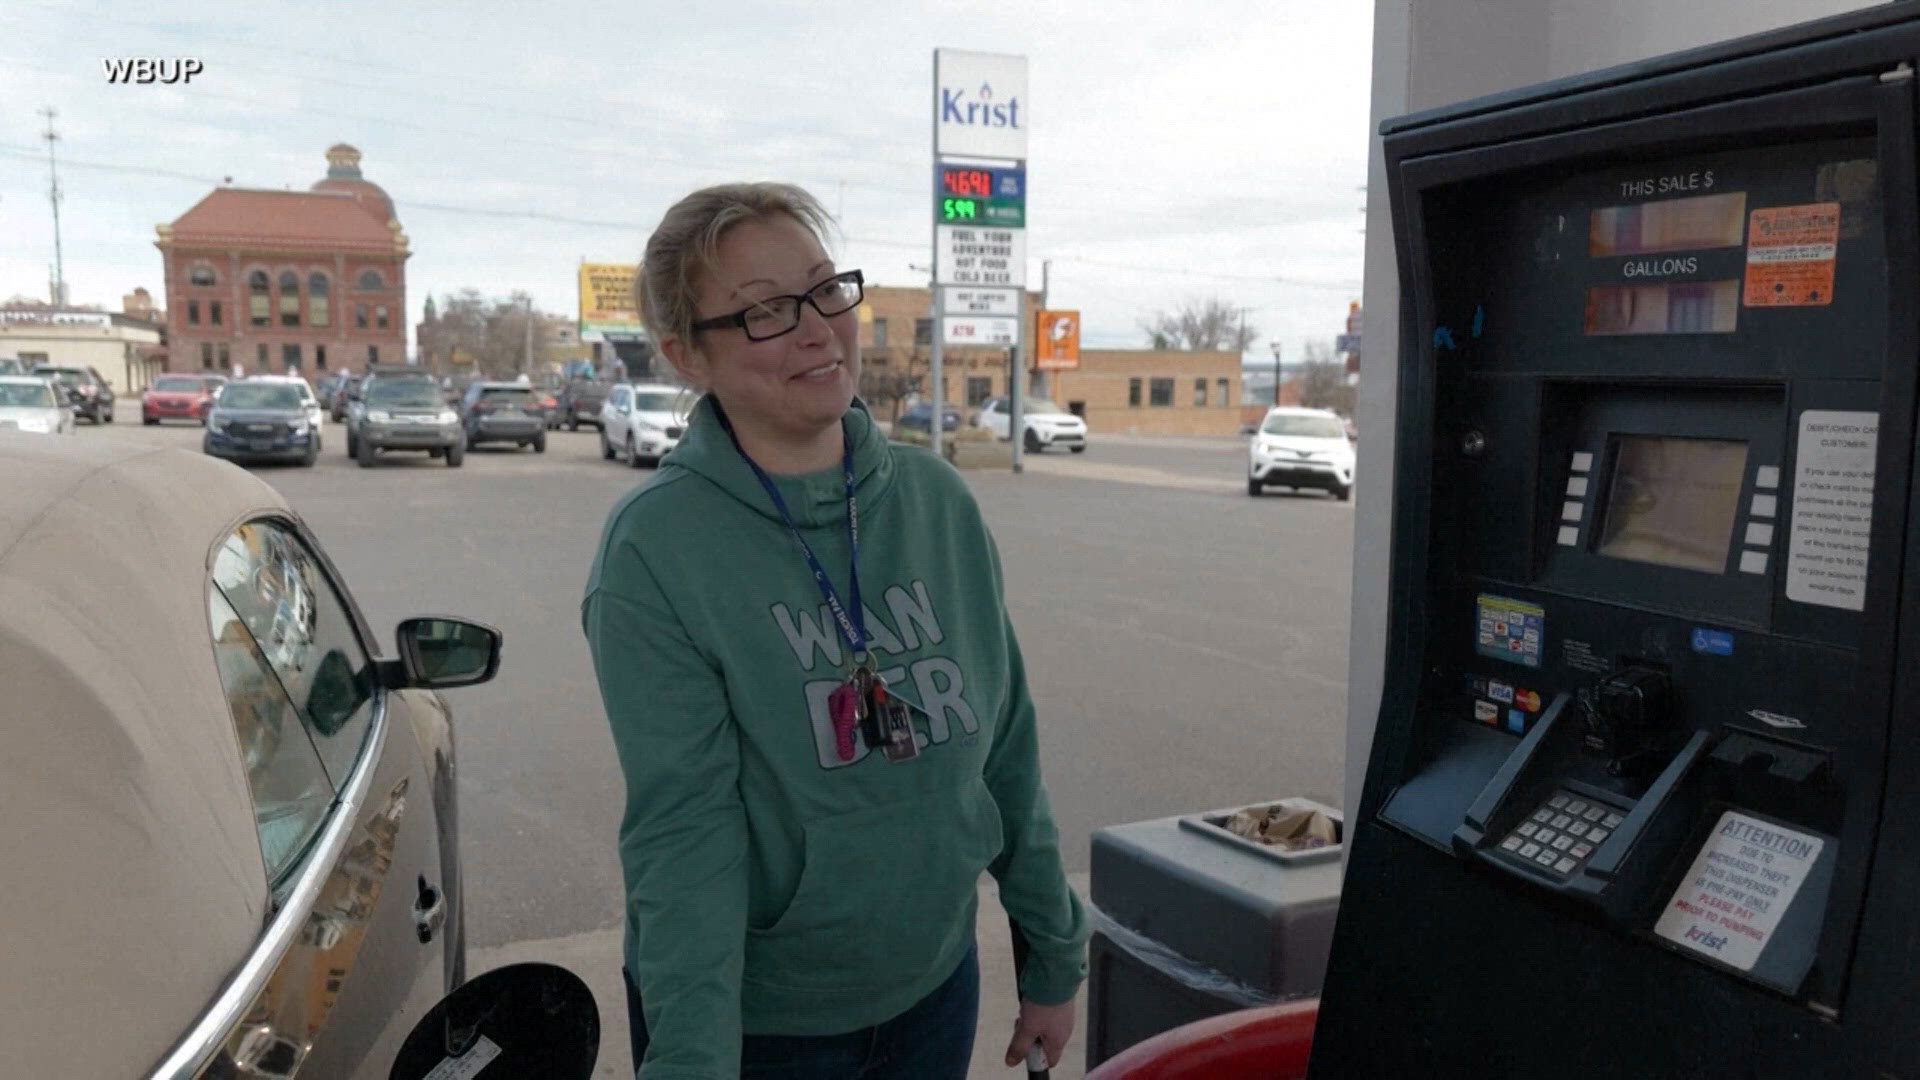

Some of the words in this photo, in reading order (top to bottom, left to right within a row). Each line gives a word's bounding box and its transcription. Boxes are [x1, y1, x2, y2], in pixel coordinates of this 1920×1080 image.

[942, 82, 1020, 129] Krist
[1621, 179, 1654, 197] THIS
[1658, 172, 1699, 193] SALE
[1703, 170, 1714, 188] $
[984, 231, 1012, 242] YOUR
[956, 257, 976, 268] HOT
[1623, 257, 1698, 277] GALLONS
[984, 271, 1010, 282] BEER
[952, 325, 976, 337] ATM
[1491, 686, 1512, 699] VISA
[1719, 818, 1814, 858] ATTENTION
[1761, 851, 1775, 864] TO
[1705, 865, 1727, 880] THIS
[1698, 892, 1735, 914] PLEASE
[1734, 903, 1756, 921] PAY
[1744, 893, 1772, 911] ONLY
[1705, 910, 1719, 922] TO
